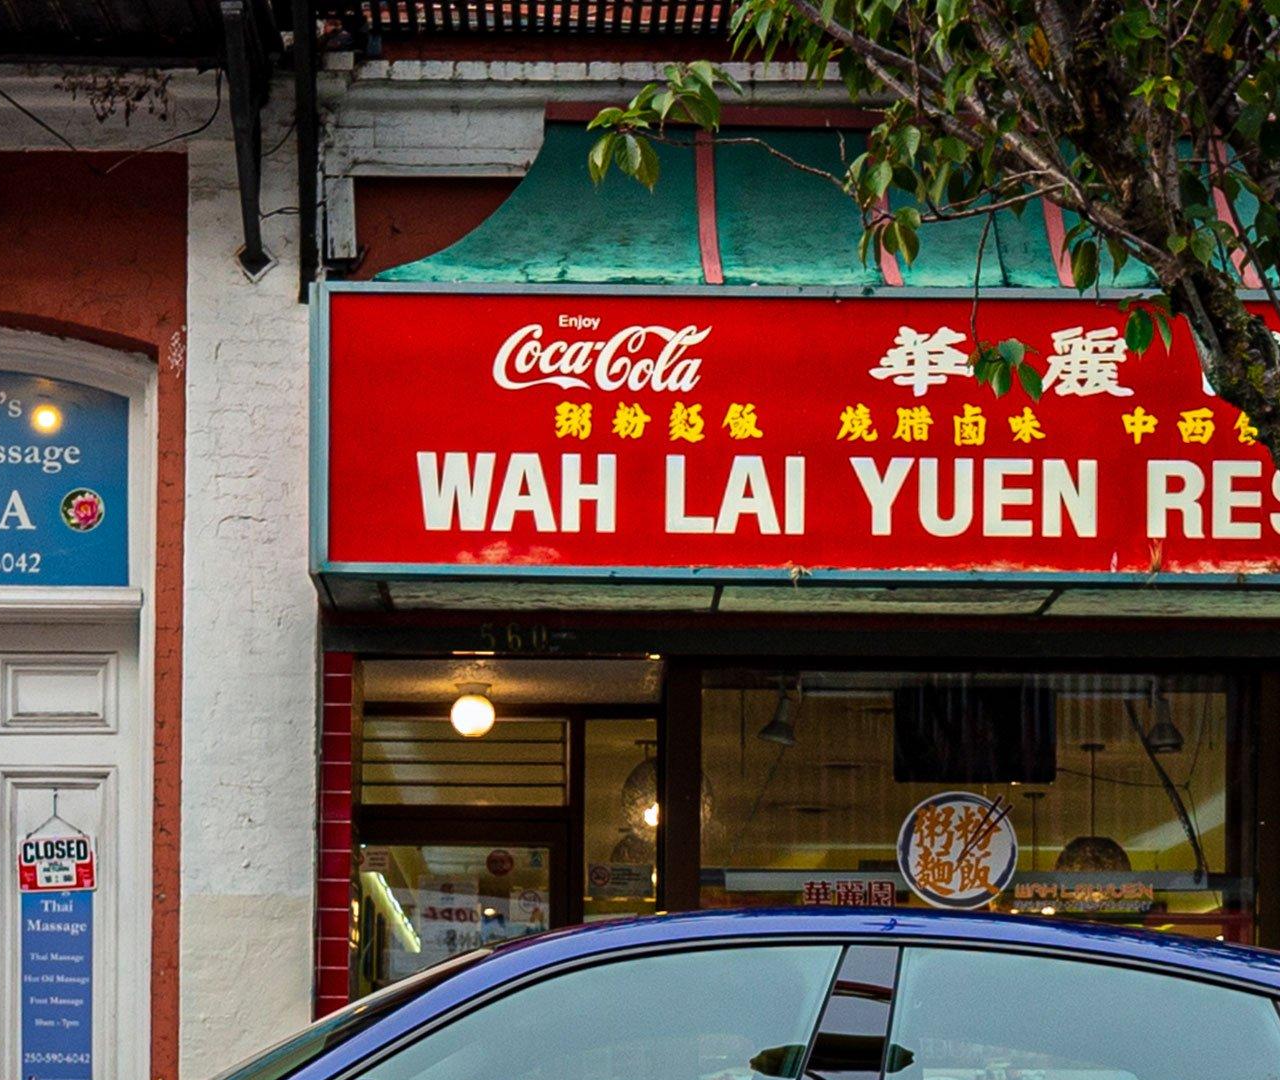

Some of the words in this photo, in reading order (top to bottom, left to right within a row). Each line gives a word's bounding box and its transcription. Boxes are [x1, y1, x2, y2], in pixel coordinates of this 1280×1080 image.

[558, 315, 600, 331] Enjoy
[493, 324, 712, 392] Coca-Cola
[416, 451, 617, 532] WAH
[665, 455, 805, 535] LAI
[848, 457, 1099, 538] YUEN
[23, 840, 88, 864] CLOSED
[41, 900, 73, 913] Thai
[27, 919, 88, 935] Massage
[30, 953, 48, 961] Thai
[50, 953, 84, 963] Massage
[56, 975, 90, 985] Massage
[50, 997, 84, 1007] Massage
[25, 1052, 90, 1064] 250-590-6042
